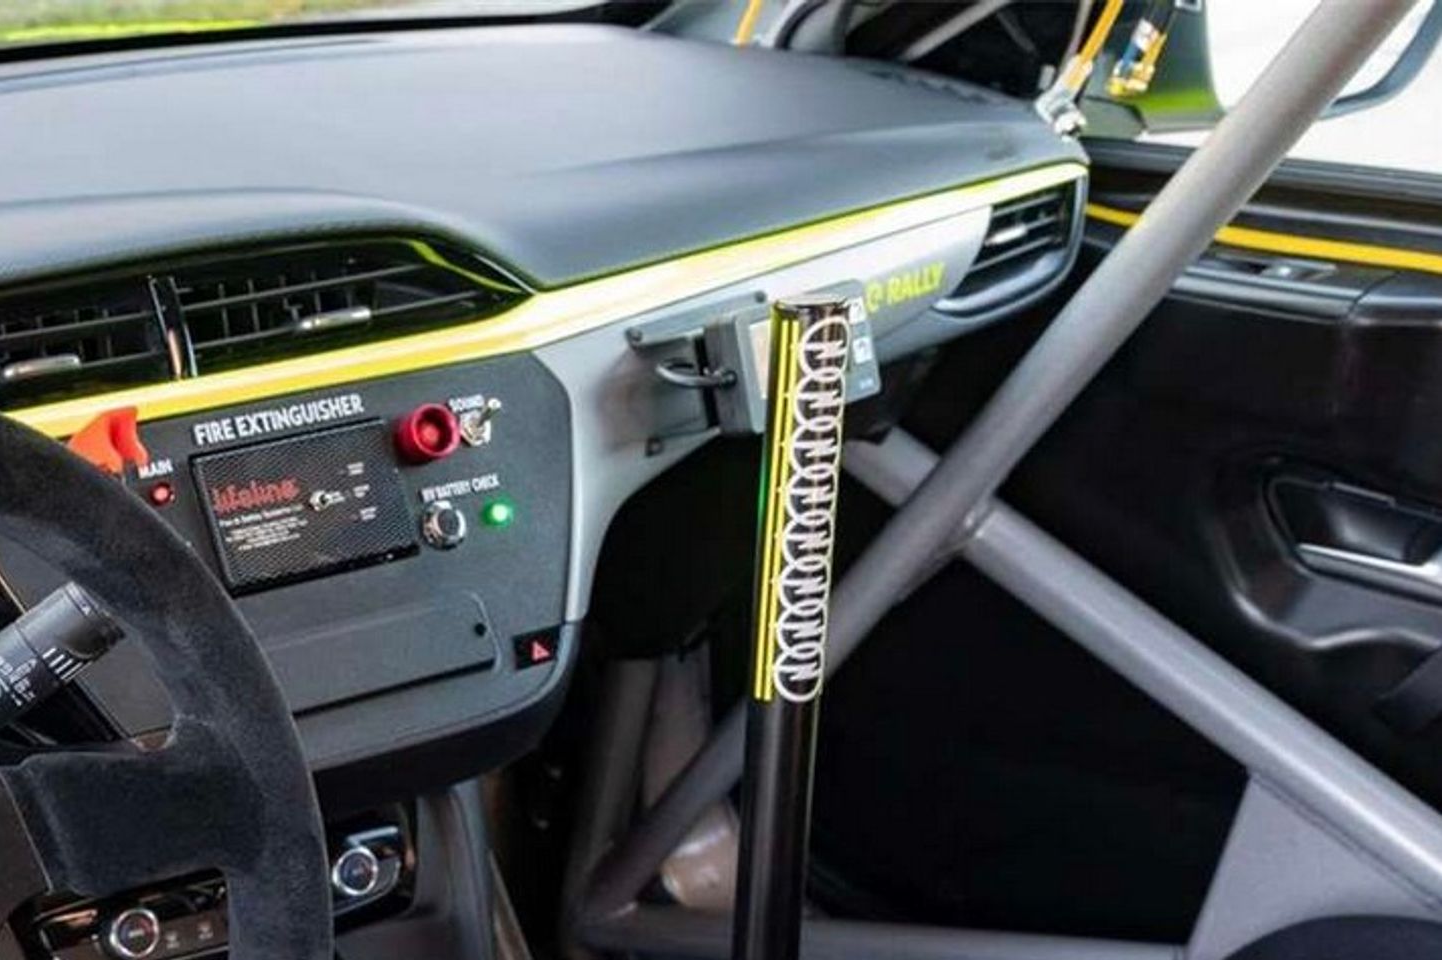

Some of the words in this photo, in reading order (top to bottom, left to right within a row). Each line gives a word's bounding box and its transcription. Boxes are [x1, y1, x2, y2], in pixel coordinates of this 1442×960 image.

[887, 262, 945, 305] RALLY
[193, 419, 235, 446] FIRE
[235, 393, 365, 437] EXTINGUISHER
